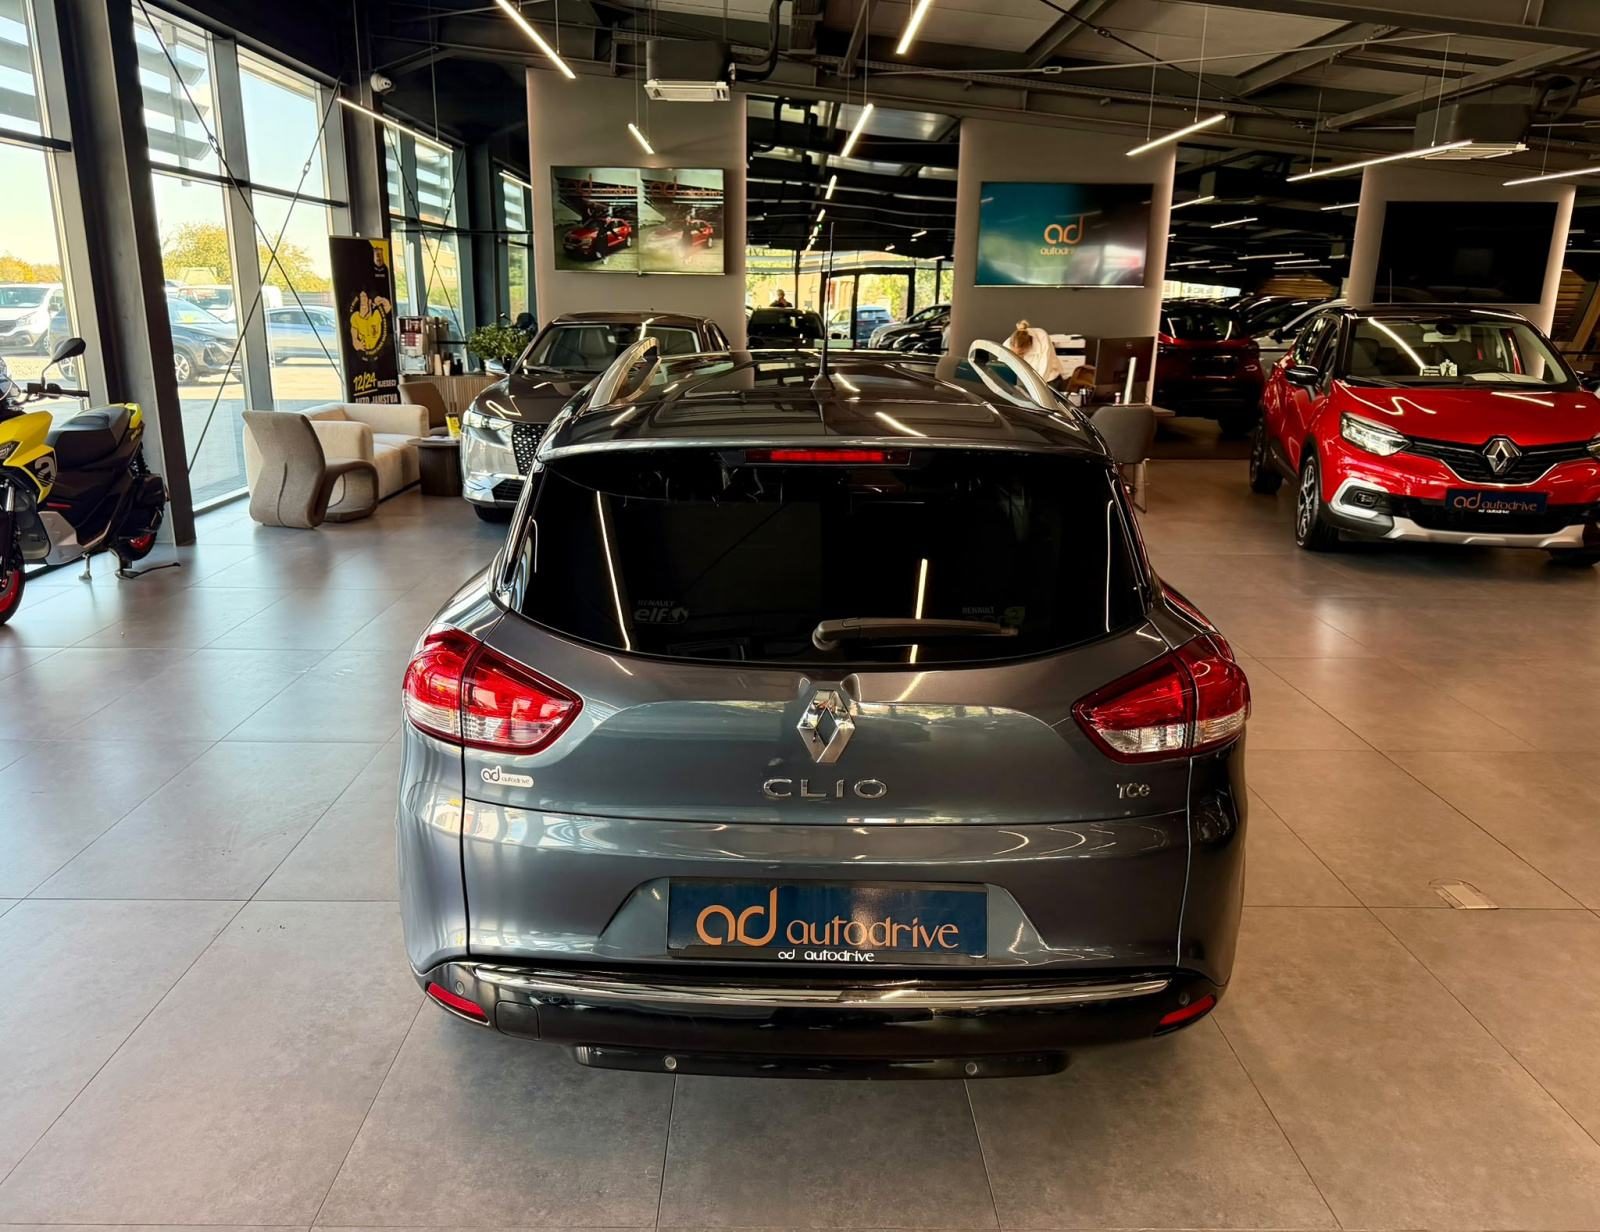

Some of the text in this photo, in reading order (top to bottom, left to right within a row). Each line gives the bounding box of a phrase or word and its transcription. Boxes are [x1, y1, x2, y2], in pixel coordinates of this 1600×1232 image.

[1044, 215, 1084, 244] ad
[353, 371, 377, 391] 12/24
[1453, 492, 1537, 512] ad autodrive
[633, 607, 669, 623] elf
[482, 767, 500, 782] ad
[763, 778, 888, 799] CLIO
[696, 887, 960, 948] ad autodrive
[777, 948, 875, 962] ad autodrive
